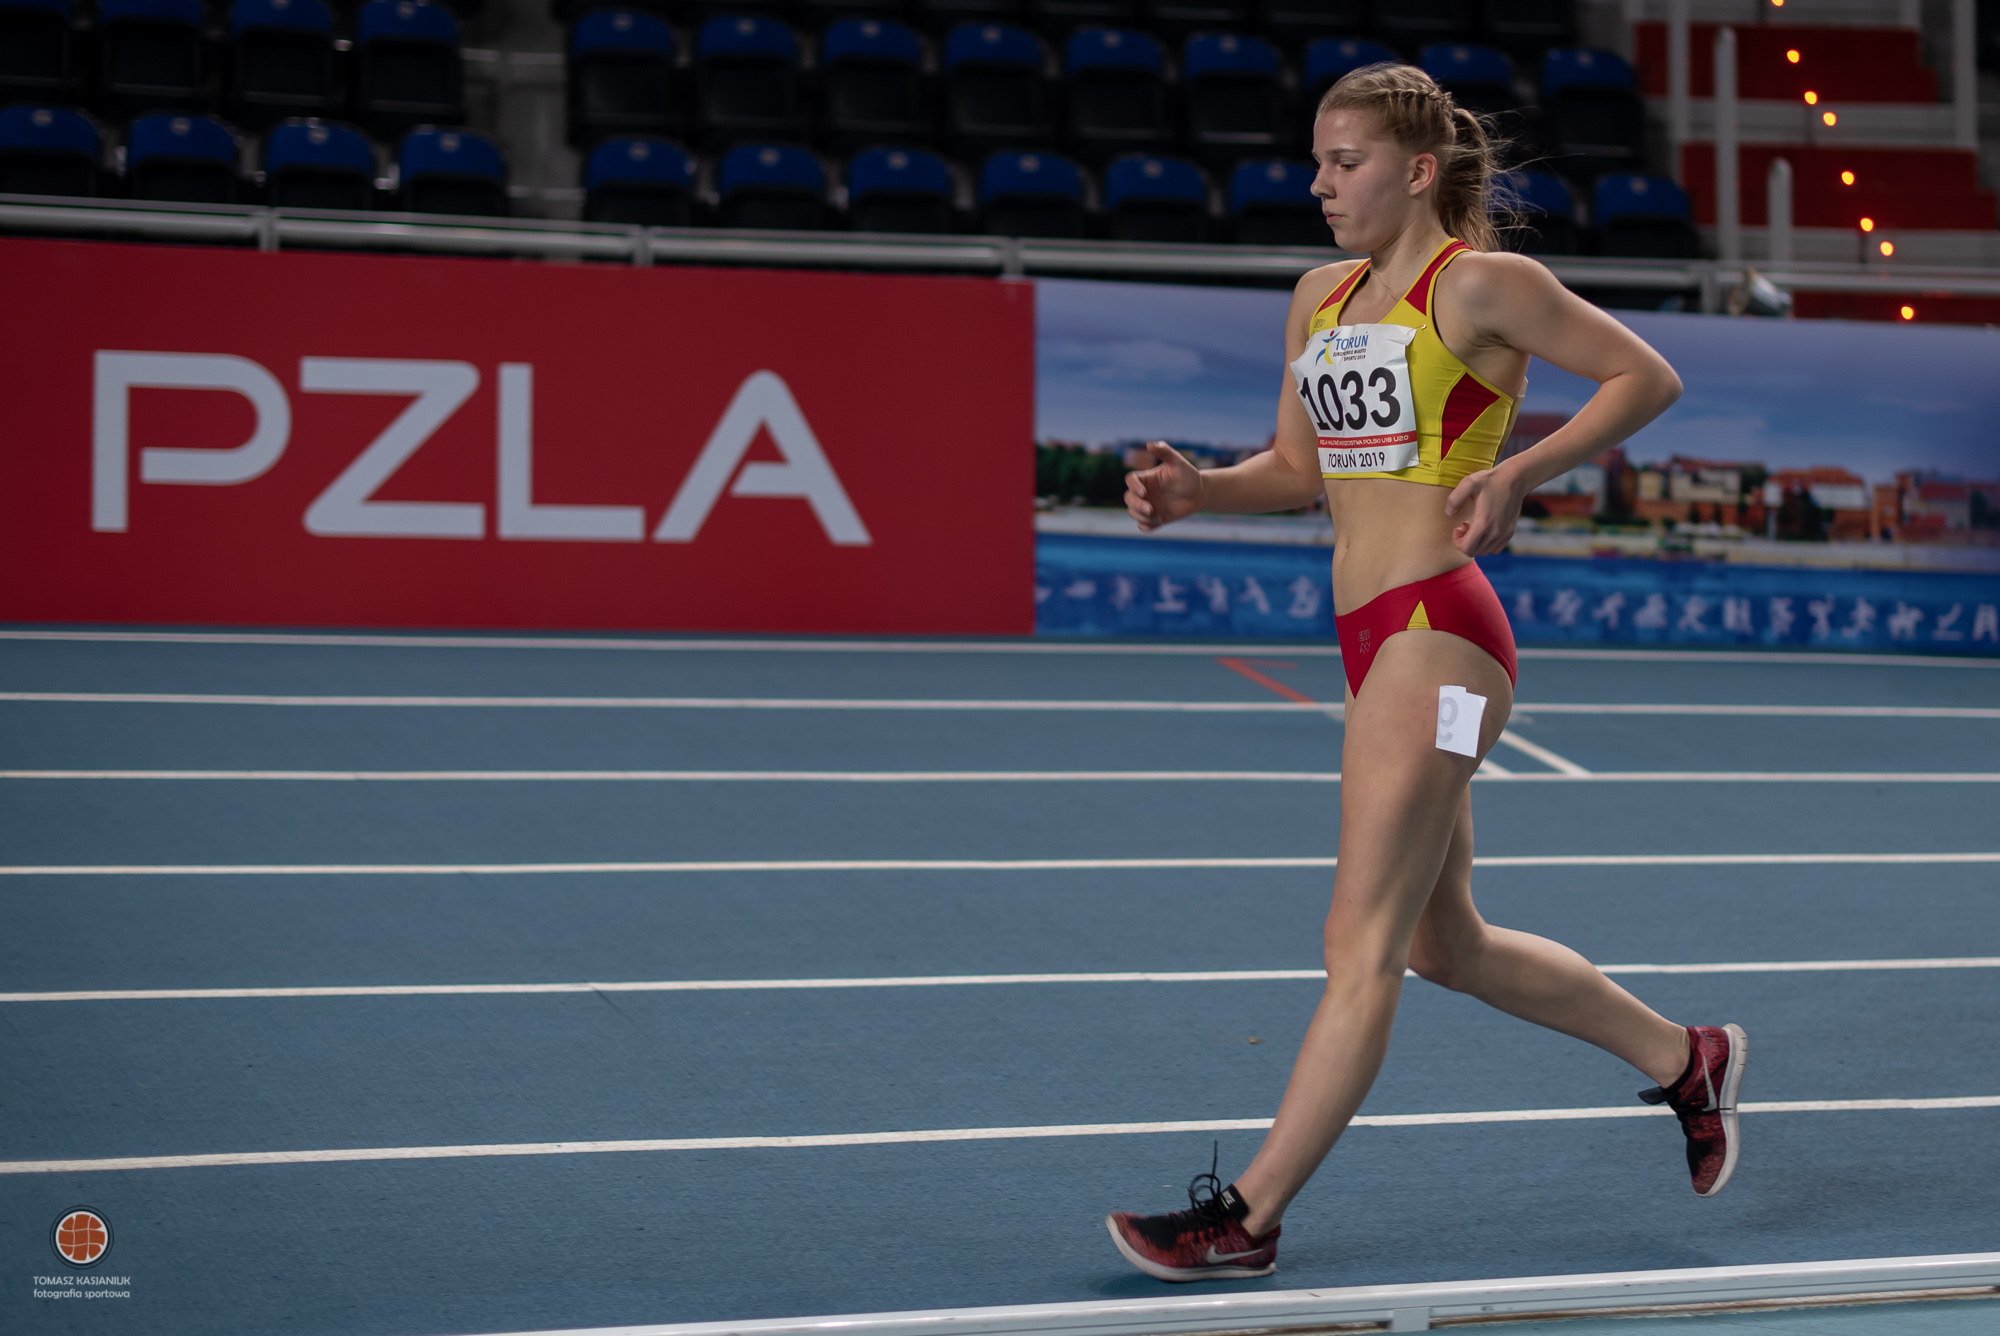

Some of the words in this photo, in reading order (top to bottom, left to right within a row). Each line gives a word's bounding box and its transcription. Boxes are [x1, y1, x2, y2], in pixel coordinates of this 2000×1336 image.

[1335, 331, 1369, 350] TORUŃ
[1300, 367, 1401, 431] 1033
[91, 349, 873, 545] PZLA
[1393, 434, 1409, 442] U20
[1328, 449, 1357, 468] TORUŃ
[1359, 451, 1385, 468] 2019
